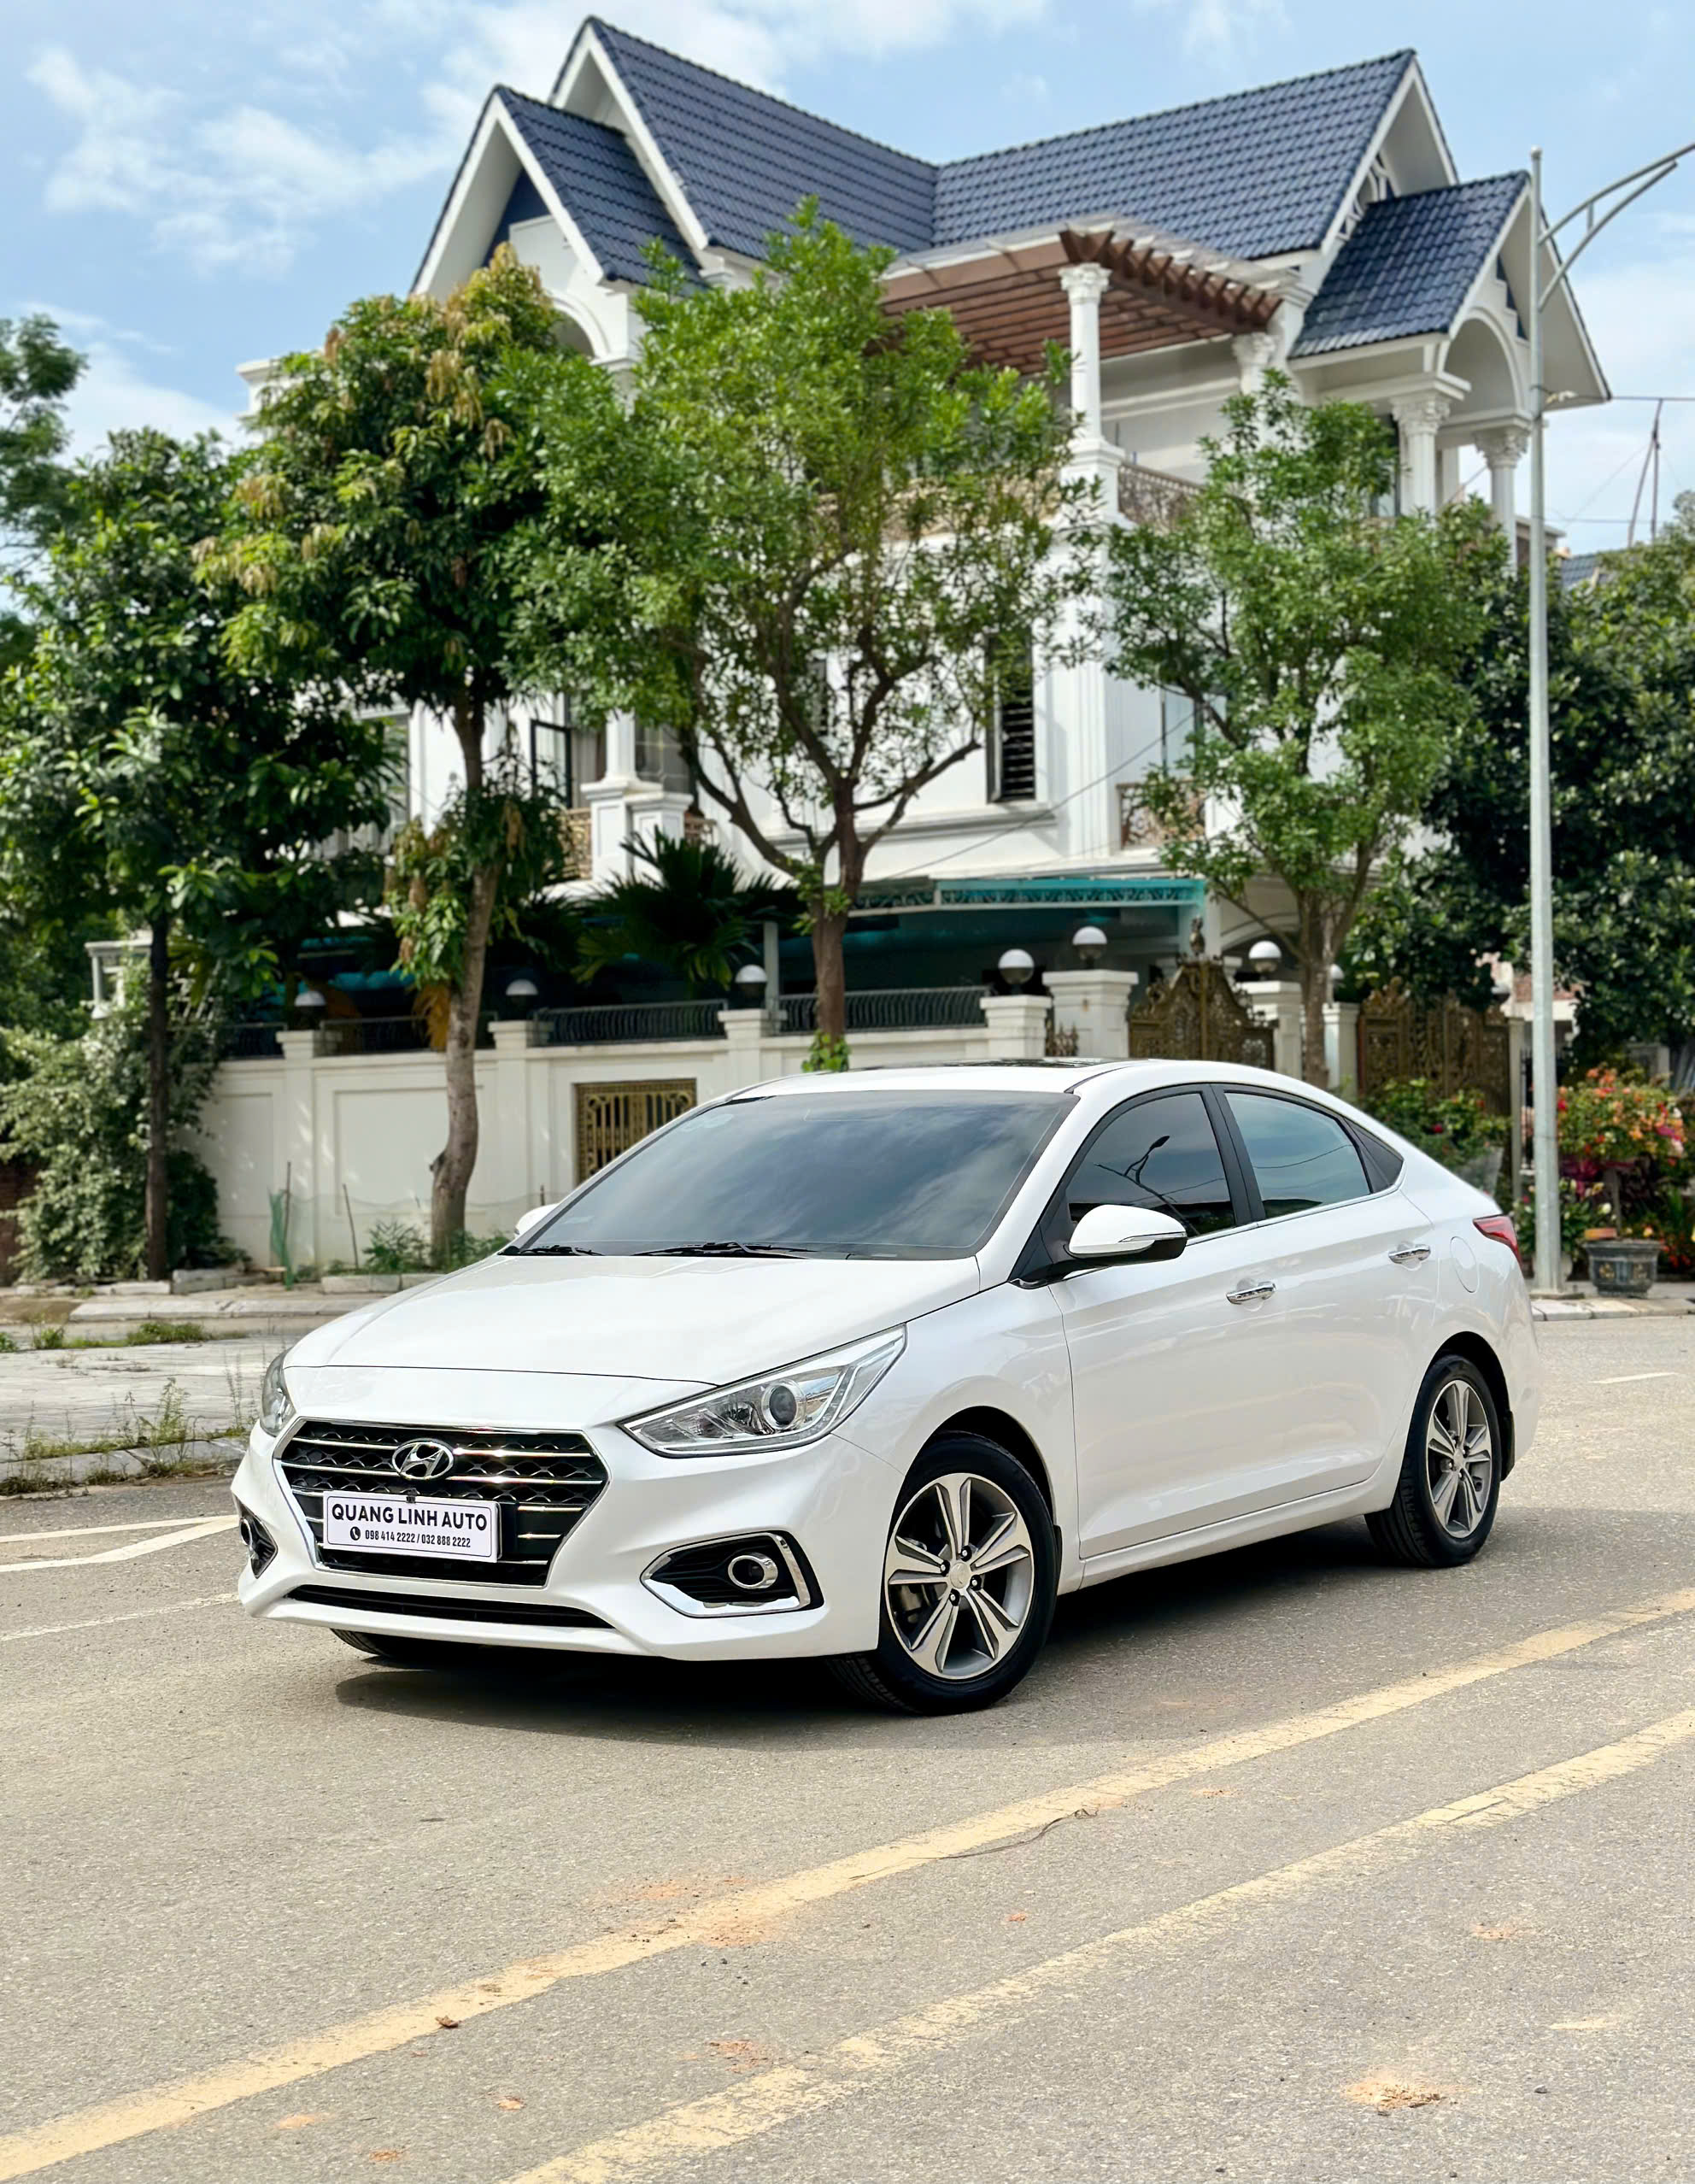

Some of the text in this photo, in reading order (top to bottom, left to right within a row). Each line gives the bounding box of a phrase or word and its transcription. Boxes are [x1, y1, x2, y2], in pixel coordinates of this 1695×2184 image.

[331, 1503, 487, 1531] QUANG LINH AUTO
[365, 1529, 379, 1541] 098
[381, 1530, 395, 1541] 414
[396, 1531, 415, 1543] 2222
[421, 1534, 435, 1545] 032
[452, 1536, 471, 1547] 2222
